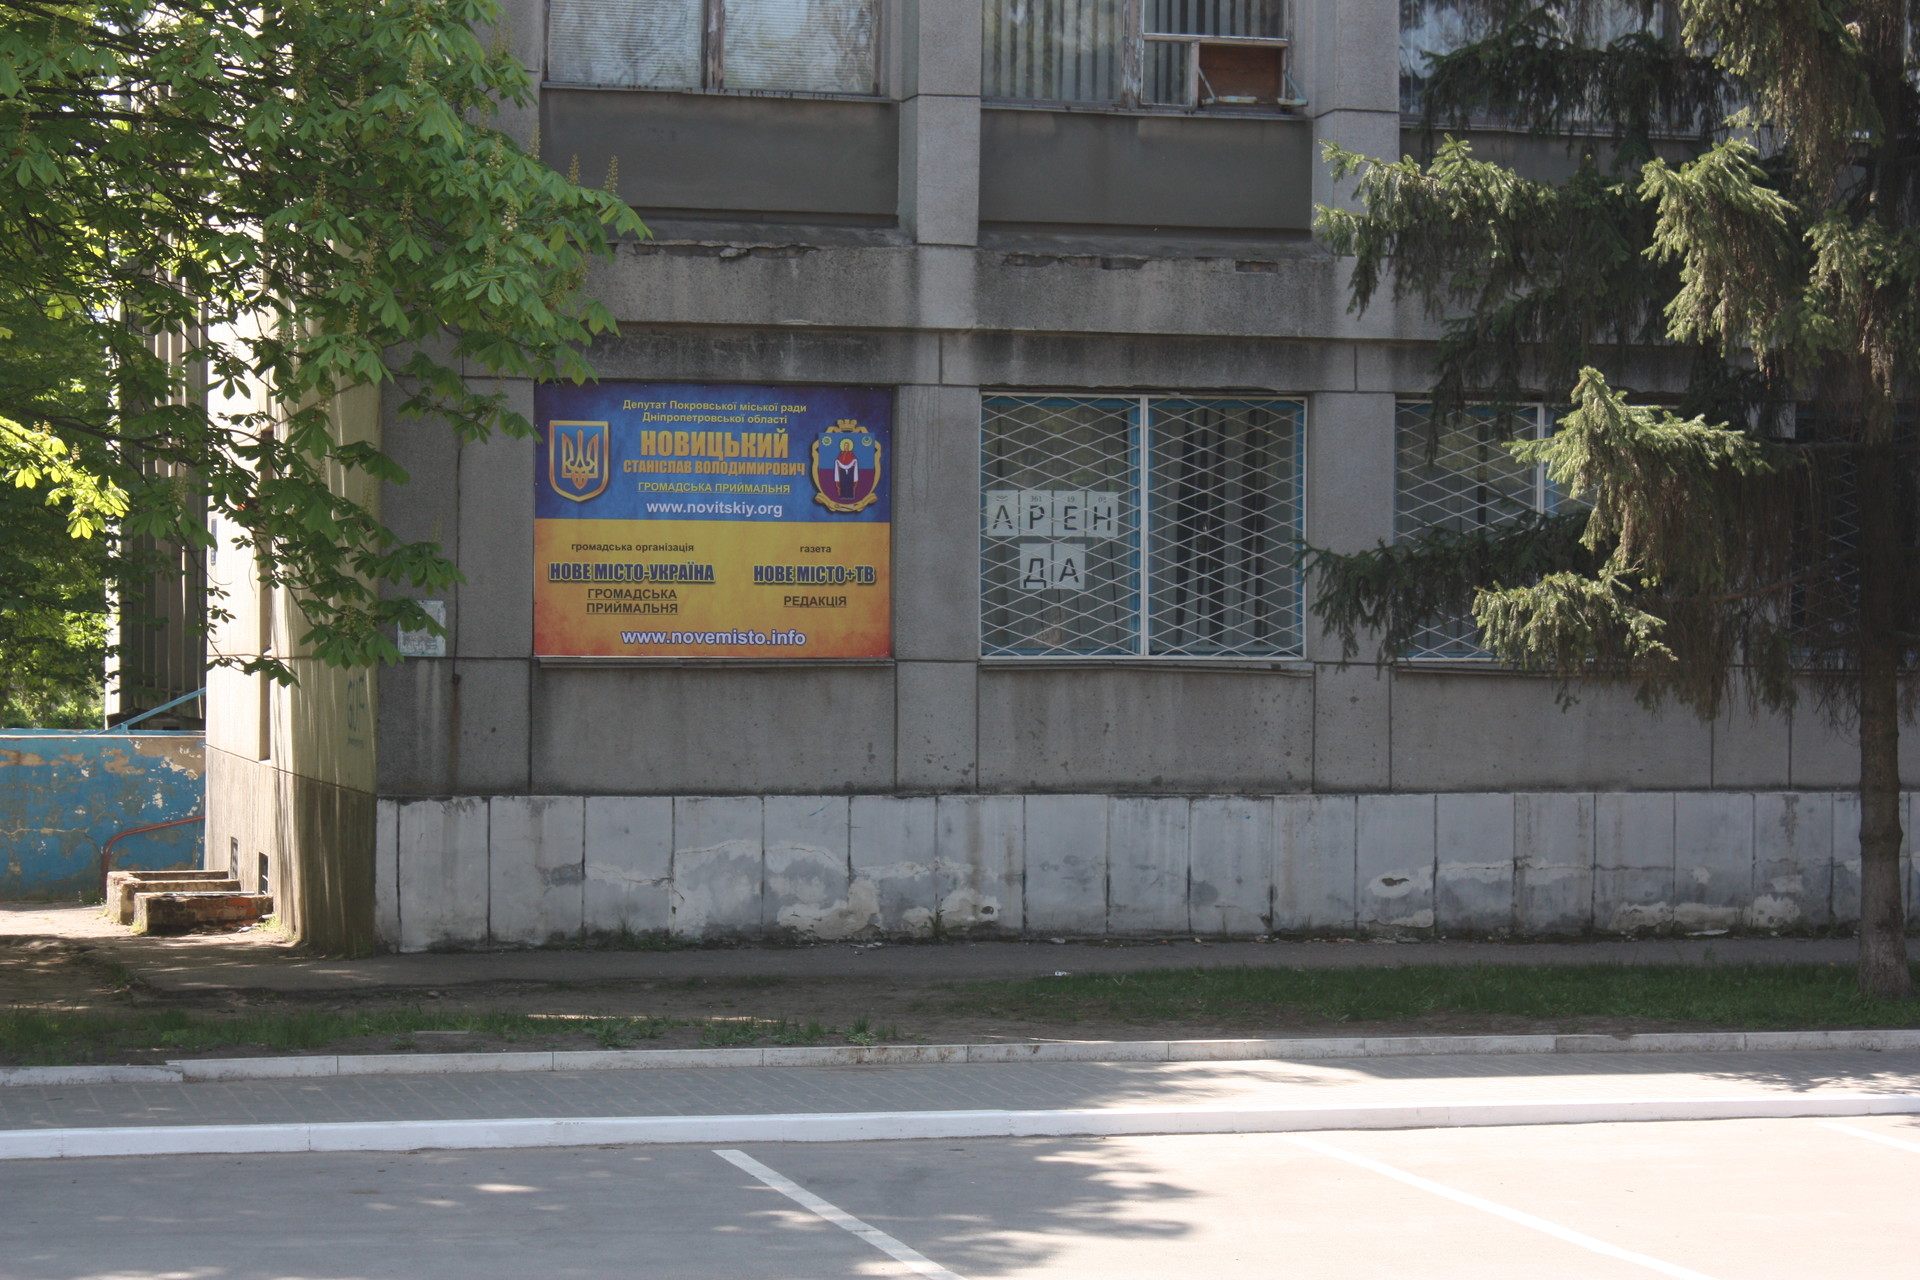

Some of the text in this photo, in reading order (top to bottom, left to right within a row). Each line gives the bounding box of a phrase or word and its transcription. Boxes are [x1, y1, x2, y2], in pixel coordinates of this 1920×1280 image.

[623, 400, 807, 414] Депутат Покровської міської ради
[642, 411, 788, 424] Дніпропетровської області
[640, 428, 789, 461] НОВИЦЬКИЙ
[623, 459, 806, 477] СТАНІСЛАВ ВОЛОДИМИРОВИЧ
[638, 481, 791, 494] ГРОМАДСЬКА ПРИЙМАЛЬНЯ
[646, 501, 783, 517] www.novitskiy.org
[571, 542, 695, 553] громадська організація
[800, 545, 832, 554] газета
[550, 563, 591, 581] НОВЕ
[753, 565, 875, 584] НОВЕ МІСТО+ТВ
[1024, 558, 1079, 588] ДА
[587, 588, 678, 600] ГРОМАДСЬКА
[783, 595, 847, 607] РЕДАКЦІЯ
[586, 601, 678, 614] ПРИЙМАЛЬНЯ
[621, 629, 806, 646] www.novemisto.info
